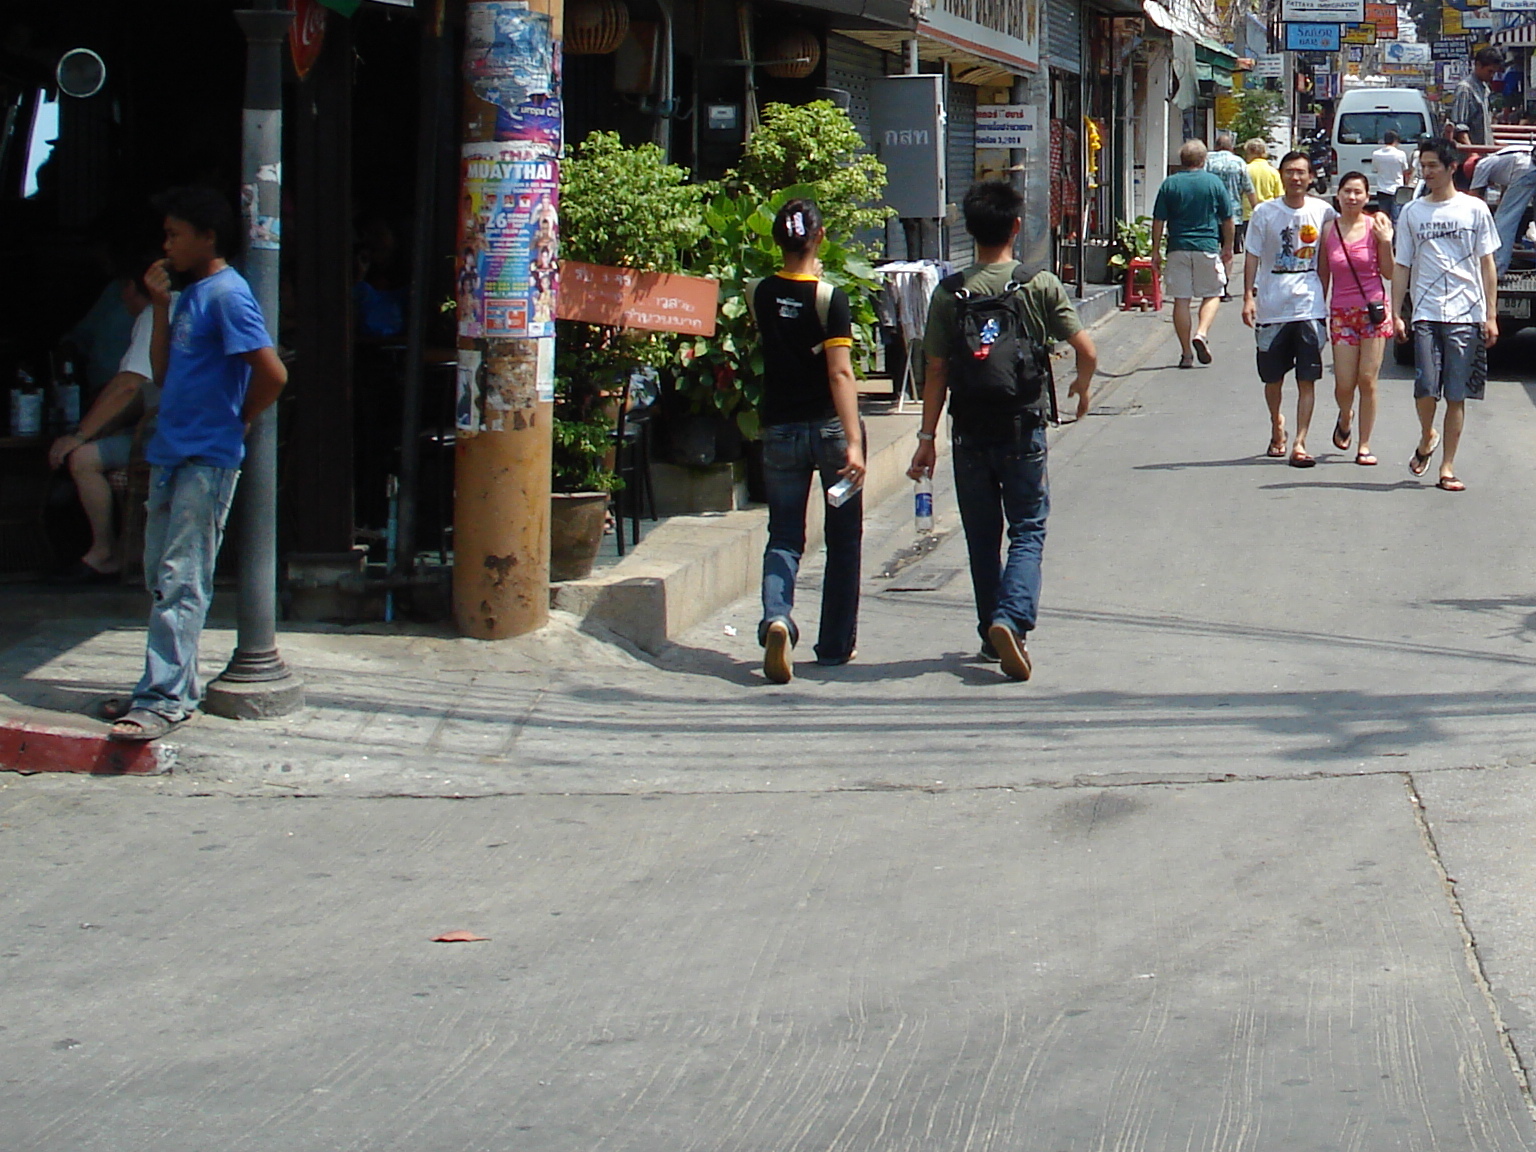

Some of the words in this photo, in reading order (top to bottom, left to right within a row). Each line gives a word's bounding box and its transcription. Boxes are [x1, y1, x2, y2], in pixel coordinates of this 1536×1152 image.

[1297, 27, 1333, 37] SAILOR
[1299, 38, 1318, 46] BAR
[885, 127, 929, 147] กสท
[485, 212, 507, 228] 26
[1419, 221, 1459, 231] ARMANI
